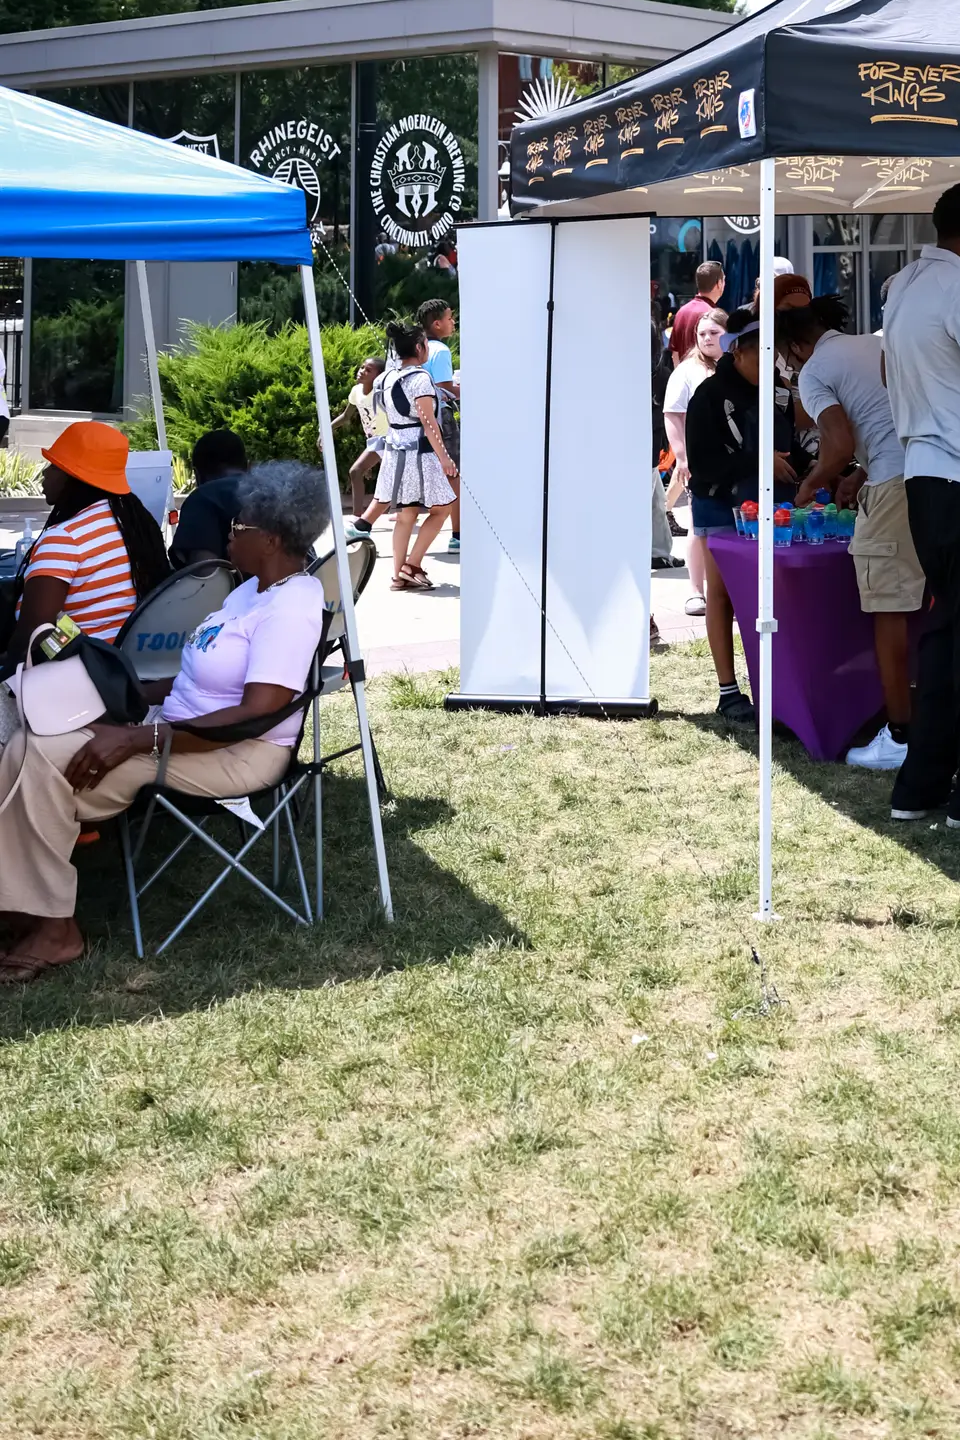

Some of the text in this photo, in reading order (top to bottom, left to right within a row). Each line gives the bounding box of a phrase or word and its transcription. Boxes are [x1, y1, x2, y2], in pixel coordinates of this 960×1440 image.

[861, 81, 946, 111] KINGS
[399, 114, 447, 139] MOERLEIN
[250, 120, 341, 167] RHINEGEIST
[268, 145, 321, 169] CINCY MADE
[370, 124, 400, 186] CHRISTIAN
[442, 132, 466, 192] BREWING
[370, 188, 386, 215] THE
[380, 212, 454, 247] CINCINNATI, OHIO
